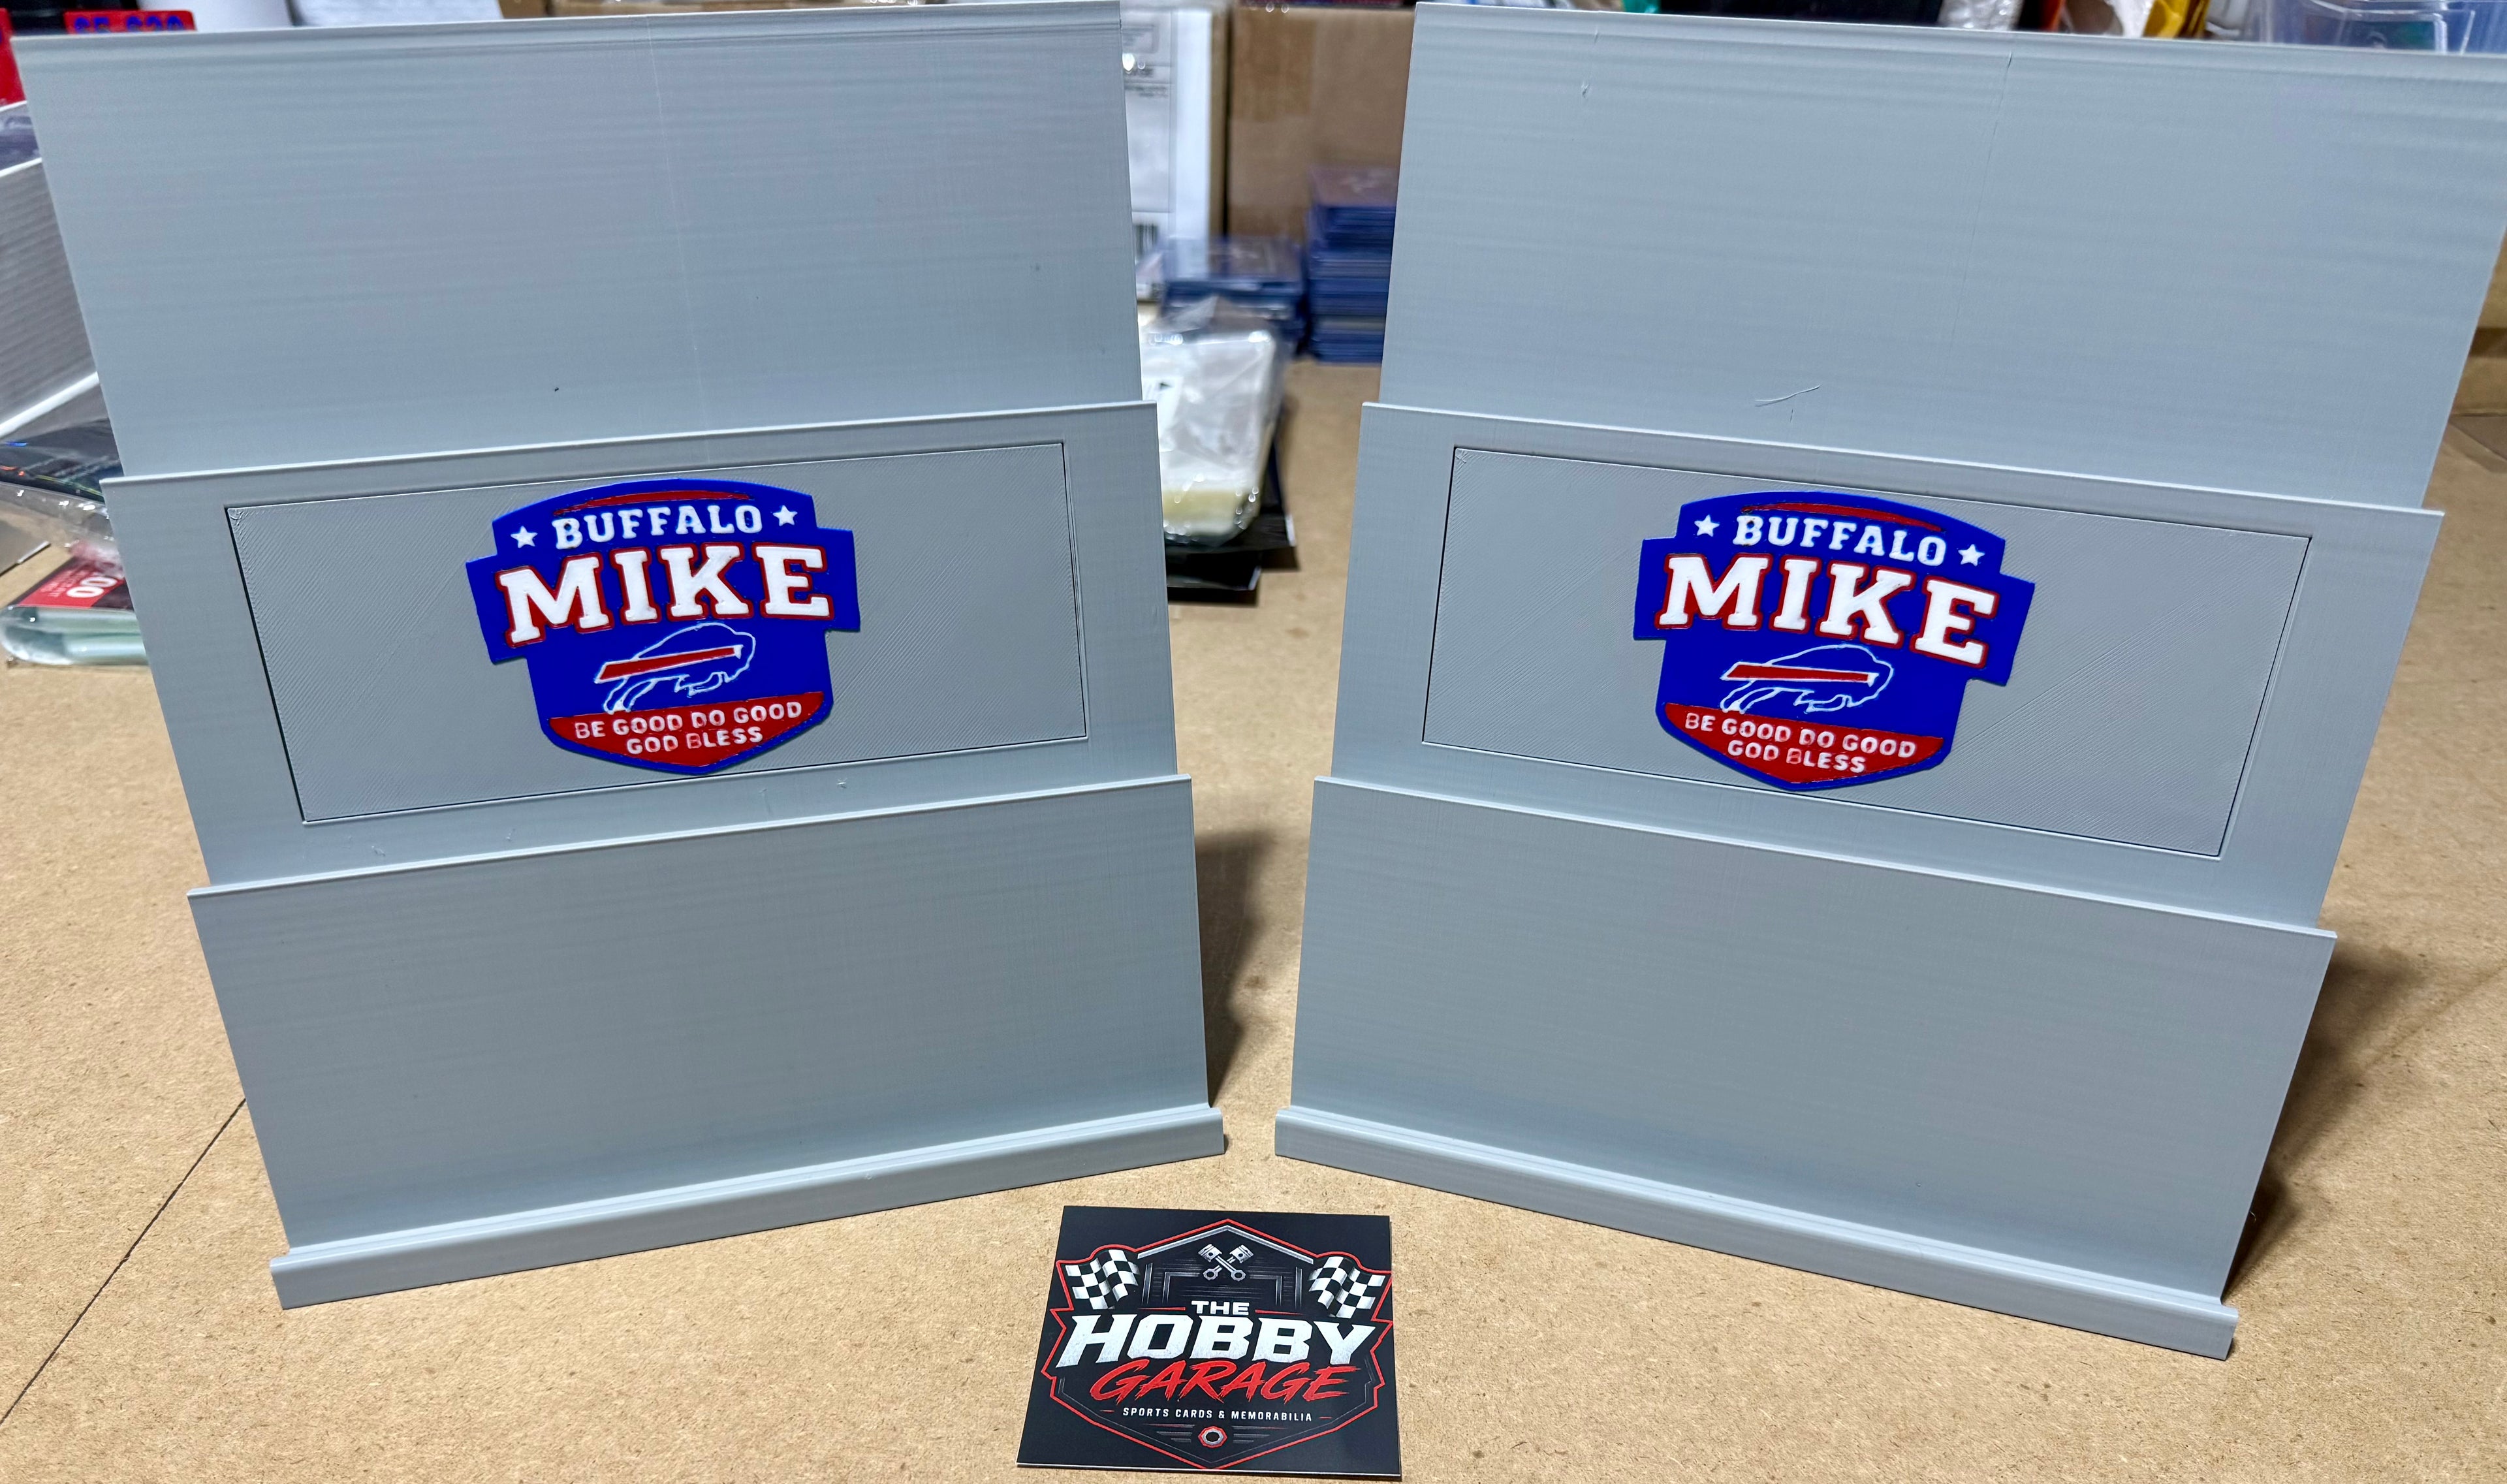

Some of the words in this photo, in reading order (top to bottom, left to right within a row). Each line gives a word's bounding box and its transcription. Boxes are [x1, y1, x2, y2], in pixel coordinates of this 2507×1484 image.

[552, 505, 762, 550] BUFFALO
[1732, 514, 1947, 566] BUFFALO
[496, 542, 834, 648] MIKE
[1655, 554, 1999, 668] MIKE
[575, 721, 605, 740] BE
[612, 714, 683, 736] GOOD
[692, 709, 725, 731] DO
[733, 701, 802, 724] GOOD
[627, 735, 678, 755] GOD
[687, 726, 763, 750] BLESS
[1684, 712, 1715, 732] BE
[1721, 718, 1791, 742] GOOD
[1799, 729, 1835, 749] DO
[1842, 734, 1916, 758] GOOD
[1727, 740, 1779, 763] GOD
[1786, 748, 1867, 774] BLESS
[1191, 1300, 1250, 1316] THE
[1056, 1314, 1376, 1368] HOBBY
[1089, 1359, 1361, 1404] GARAGE
[1122, 1406, 1169, 1418] SPORTS
[1175, 1408, 1214, 1419] CARDS
[1218, 1410, 1225, 1419] &
[1231, 1410, 1312, 1422] MEMORABILIA
